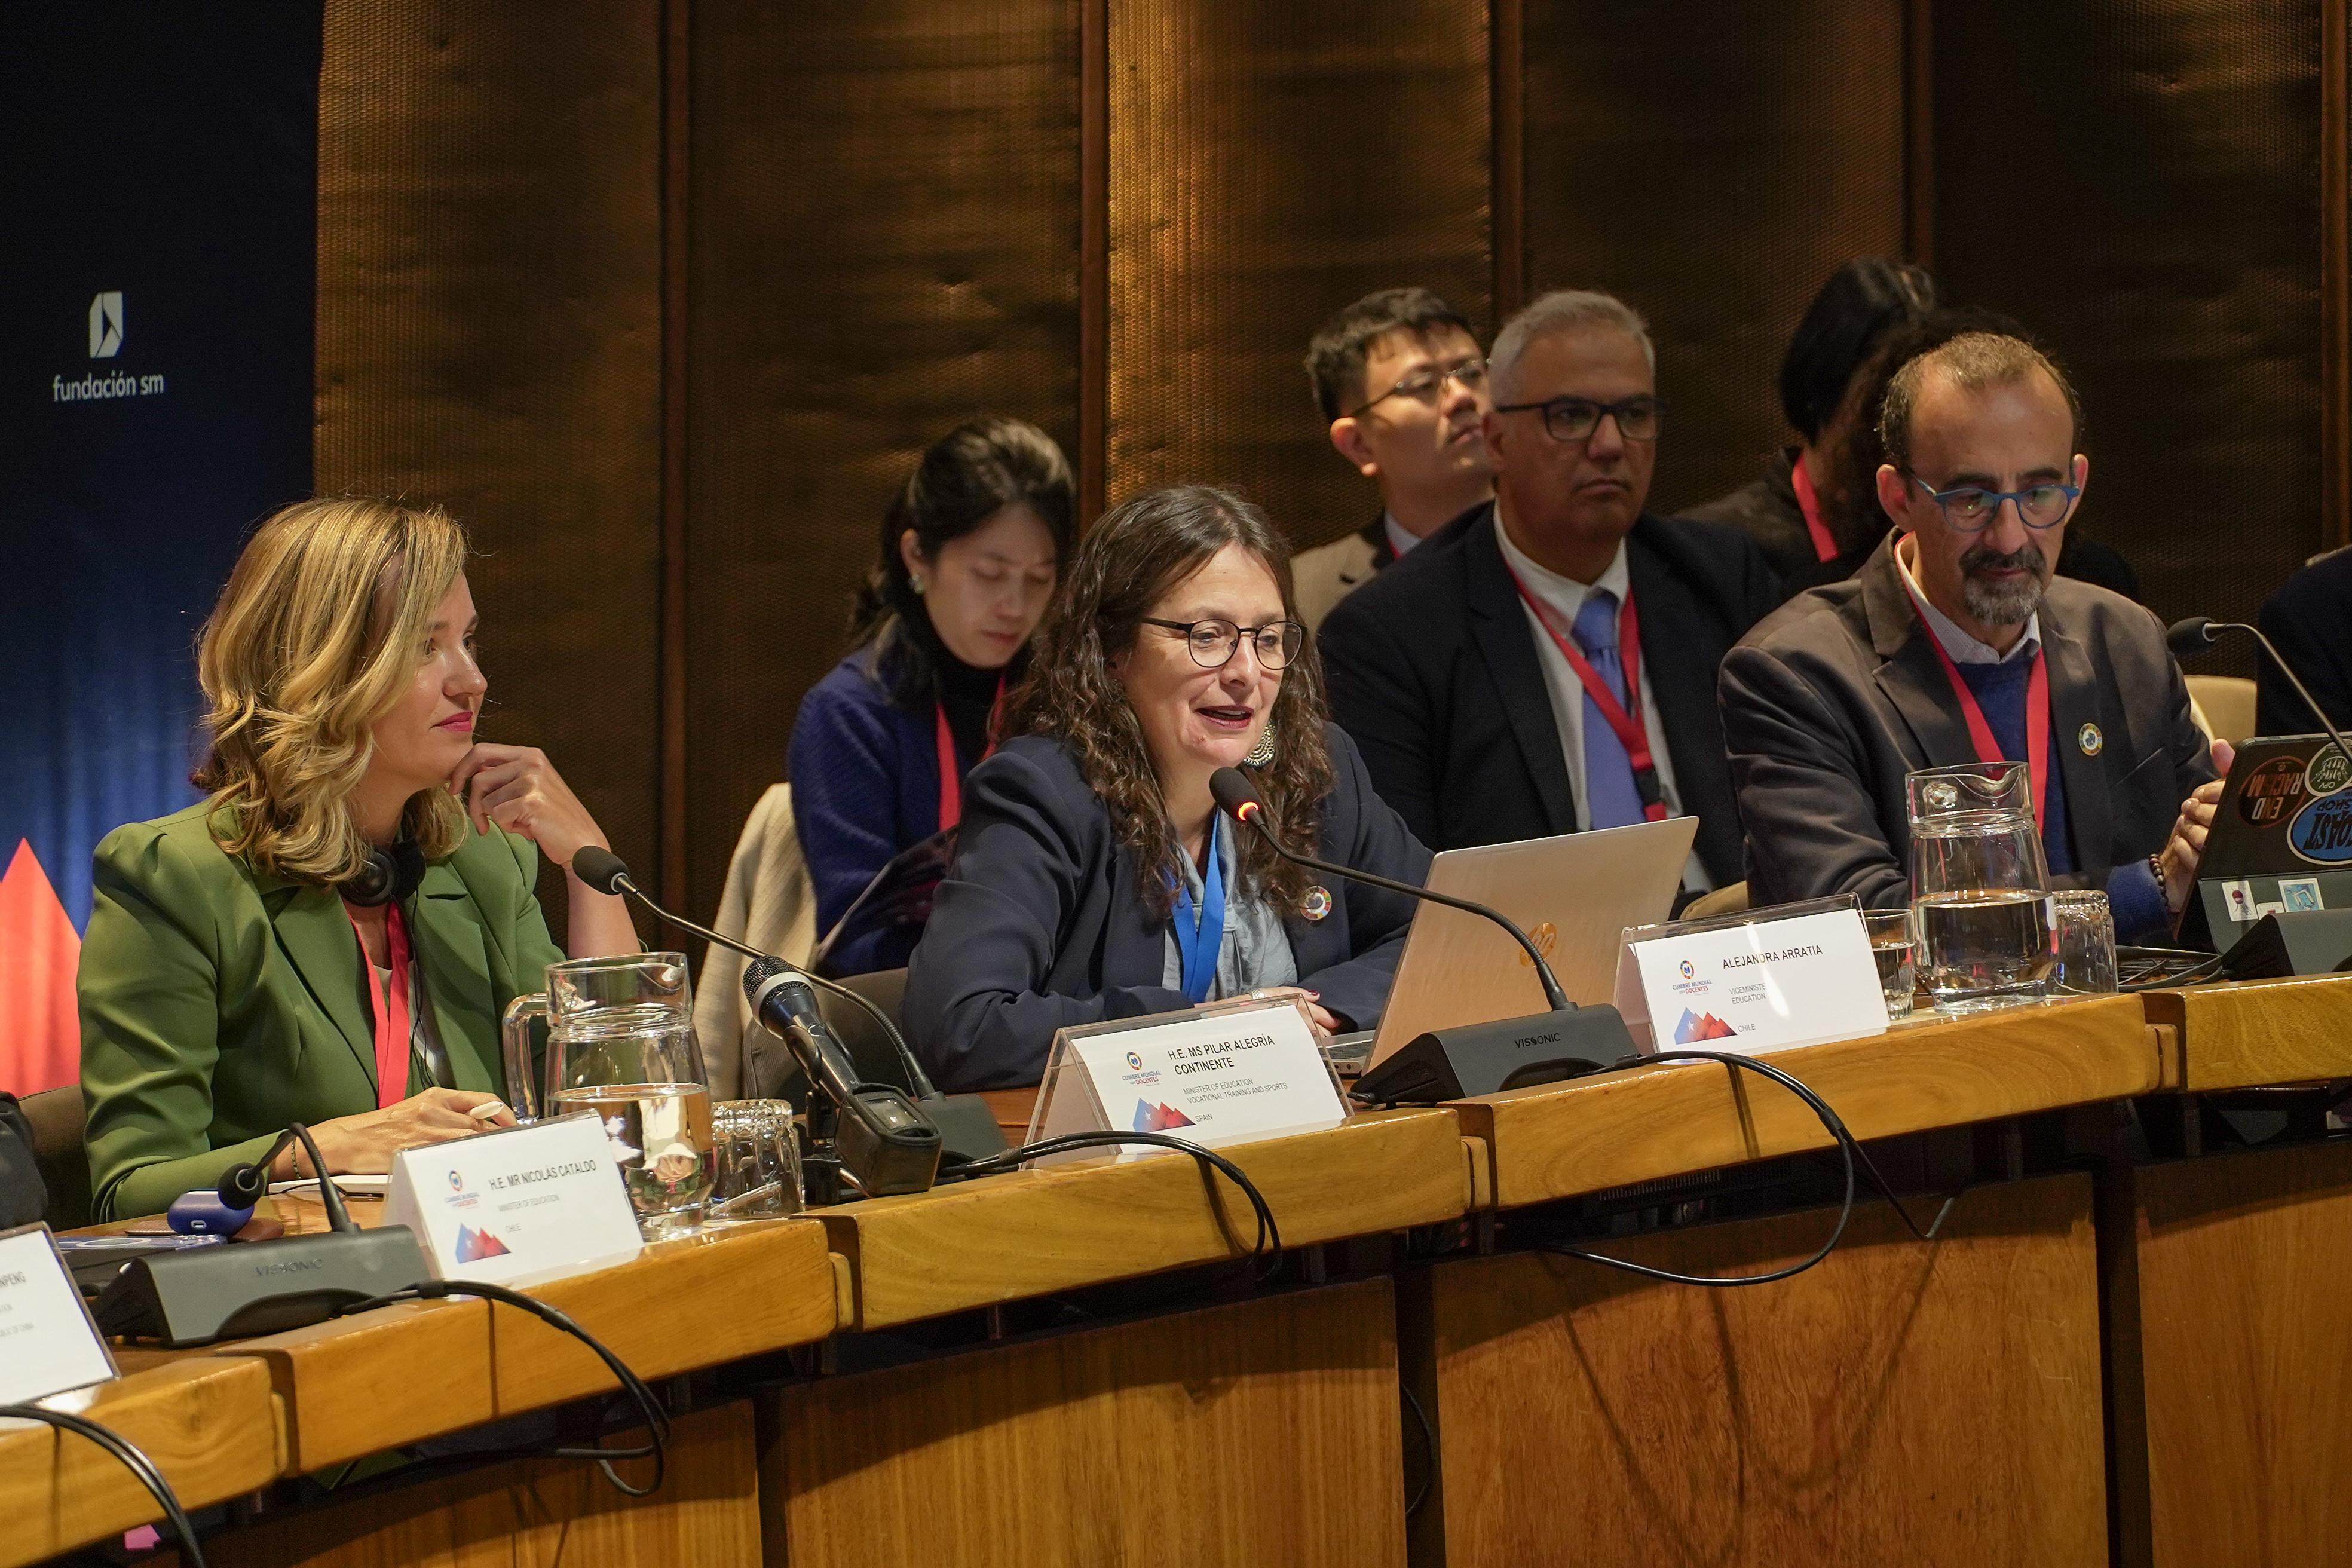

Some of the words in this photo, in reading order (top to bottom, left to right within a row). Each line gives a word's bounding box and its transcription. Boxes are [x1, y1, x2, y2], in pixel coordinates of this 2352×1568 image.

[54, 369, 136, 402] fundación
[140, 374, 164, 396] sm
[1723, 951, 1780, 969] ALEJANDRA
[1782, 945, 1823, 960] ARRATIA
[1685, 985, 1708, 994] DOCENTES
[1729, 983, 1766, 995] VICEMINISTE
[1732, 993, 1766, 1004] EDUCATION
[1738, 1023, 1756, 1033] CHILE
[1167, 1049, 1188, 1061] H.E.
[1188, 1046, 1203, 1057] MS
[1203, 1042, 1233, 1055] PILAR
[1234, 1033, 1275, 1051] ALEGRÍA
[1514, 1033, 1561, 1048] VISSONIC
[1174, 1057, 1235, 1075] CONTINENTE
[1135, 1076, 1159, 1085] DOCENTES
[1183, 1085, 1211, 1095] MINISTER
[1220, 1078, 1254, 1089] EDUCATION
[1187, 1093, 1224, 1104] VOCATIONAL
[1224, 1088, 1251, 1099] TRAINING
[1252, 1085, 1264, 1094] AND
[1264, 1082, 1288, 1092] SPORTS
[1195, 1113, 1214, 1123] SPAIN
[488, 1177, 507, 1190] H.E.
[507, 1174, 521, 1187] MR
[521, 1165, 558, 1184] NICOLÁS
[558, 1160, 596, 1177] CATALDO
[530, 1194, 560, 1206] EDUCATION
